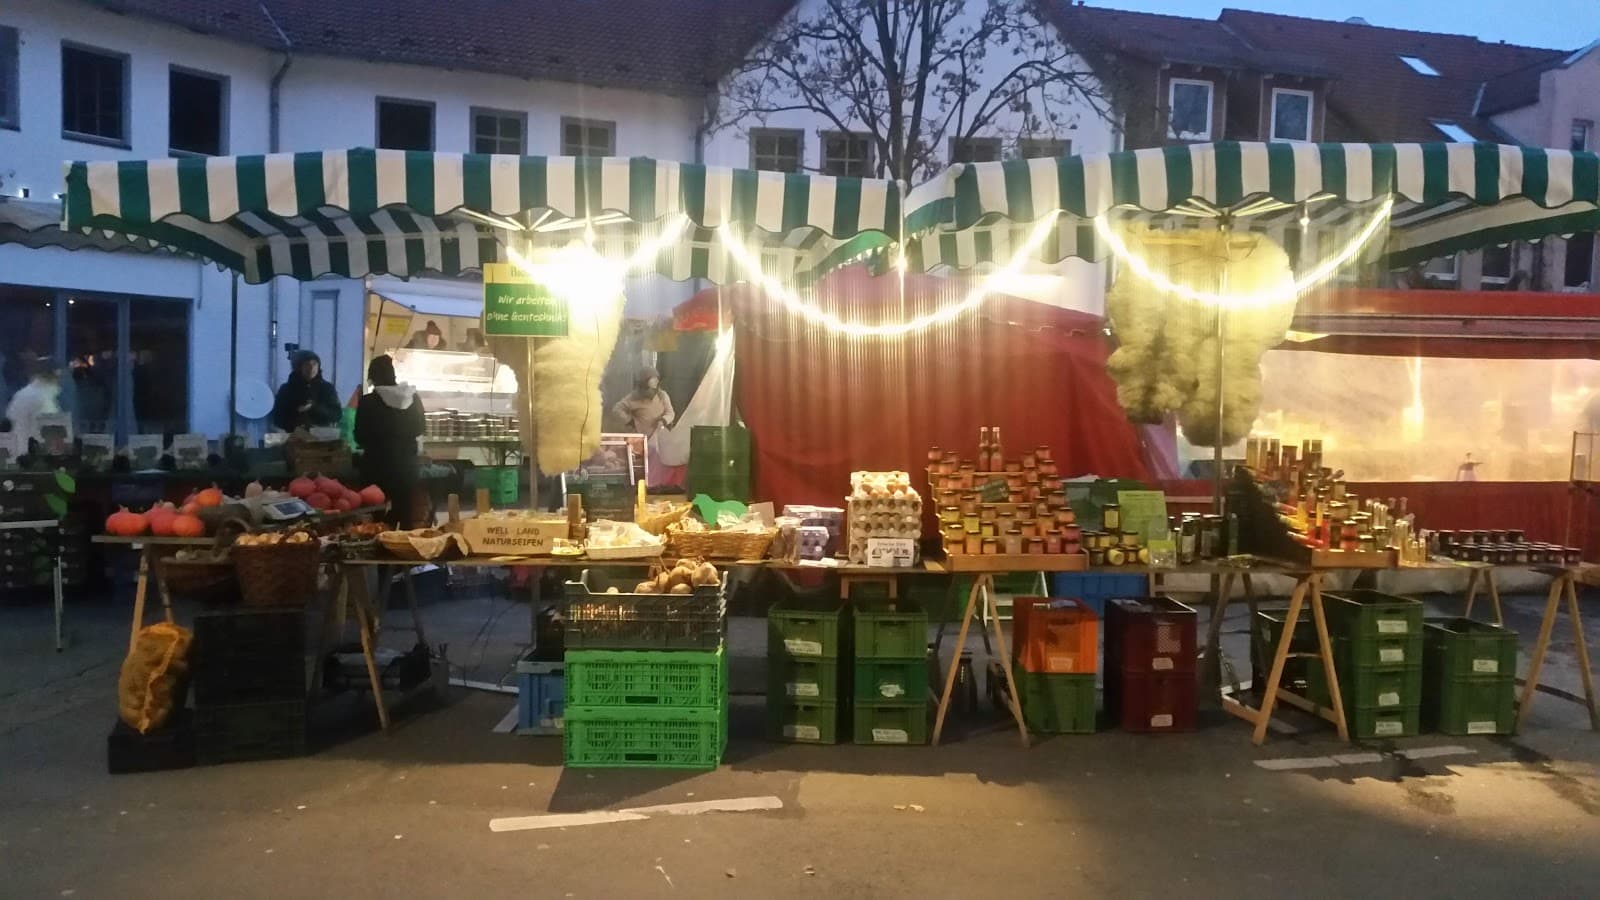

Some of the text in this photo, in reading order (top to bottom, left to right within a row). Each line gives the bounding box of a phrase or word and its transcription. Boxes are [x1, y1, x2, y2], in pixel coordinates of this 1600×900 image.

[498, 295, 514, 304] Wir
[487, 527, 540, 536] WELL LAND
[482, 537, 544, 547] NATURSEIFEN
